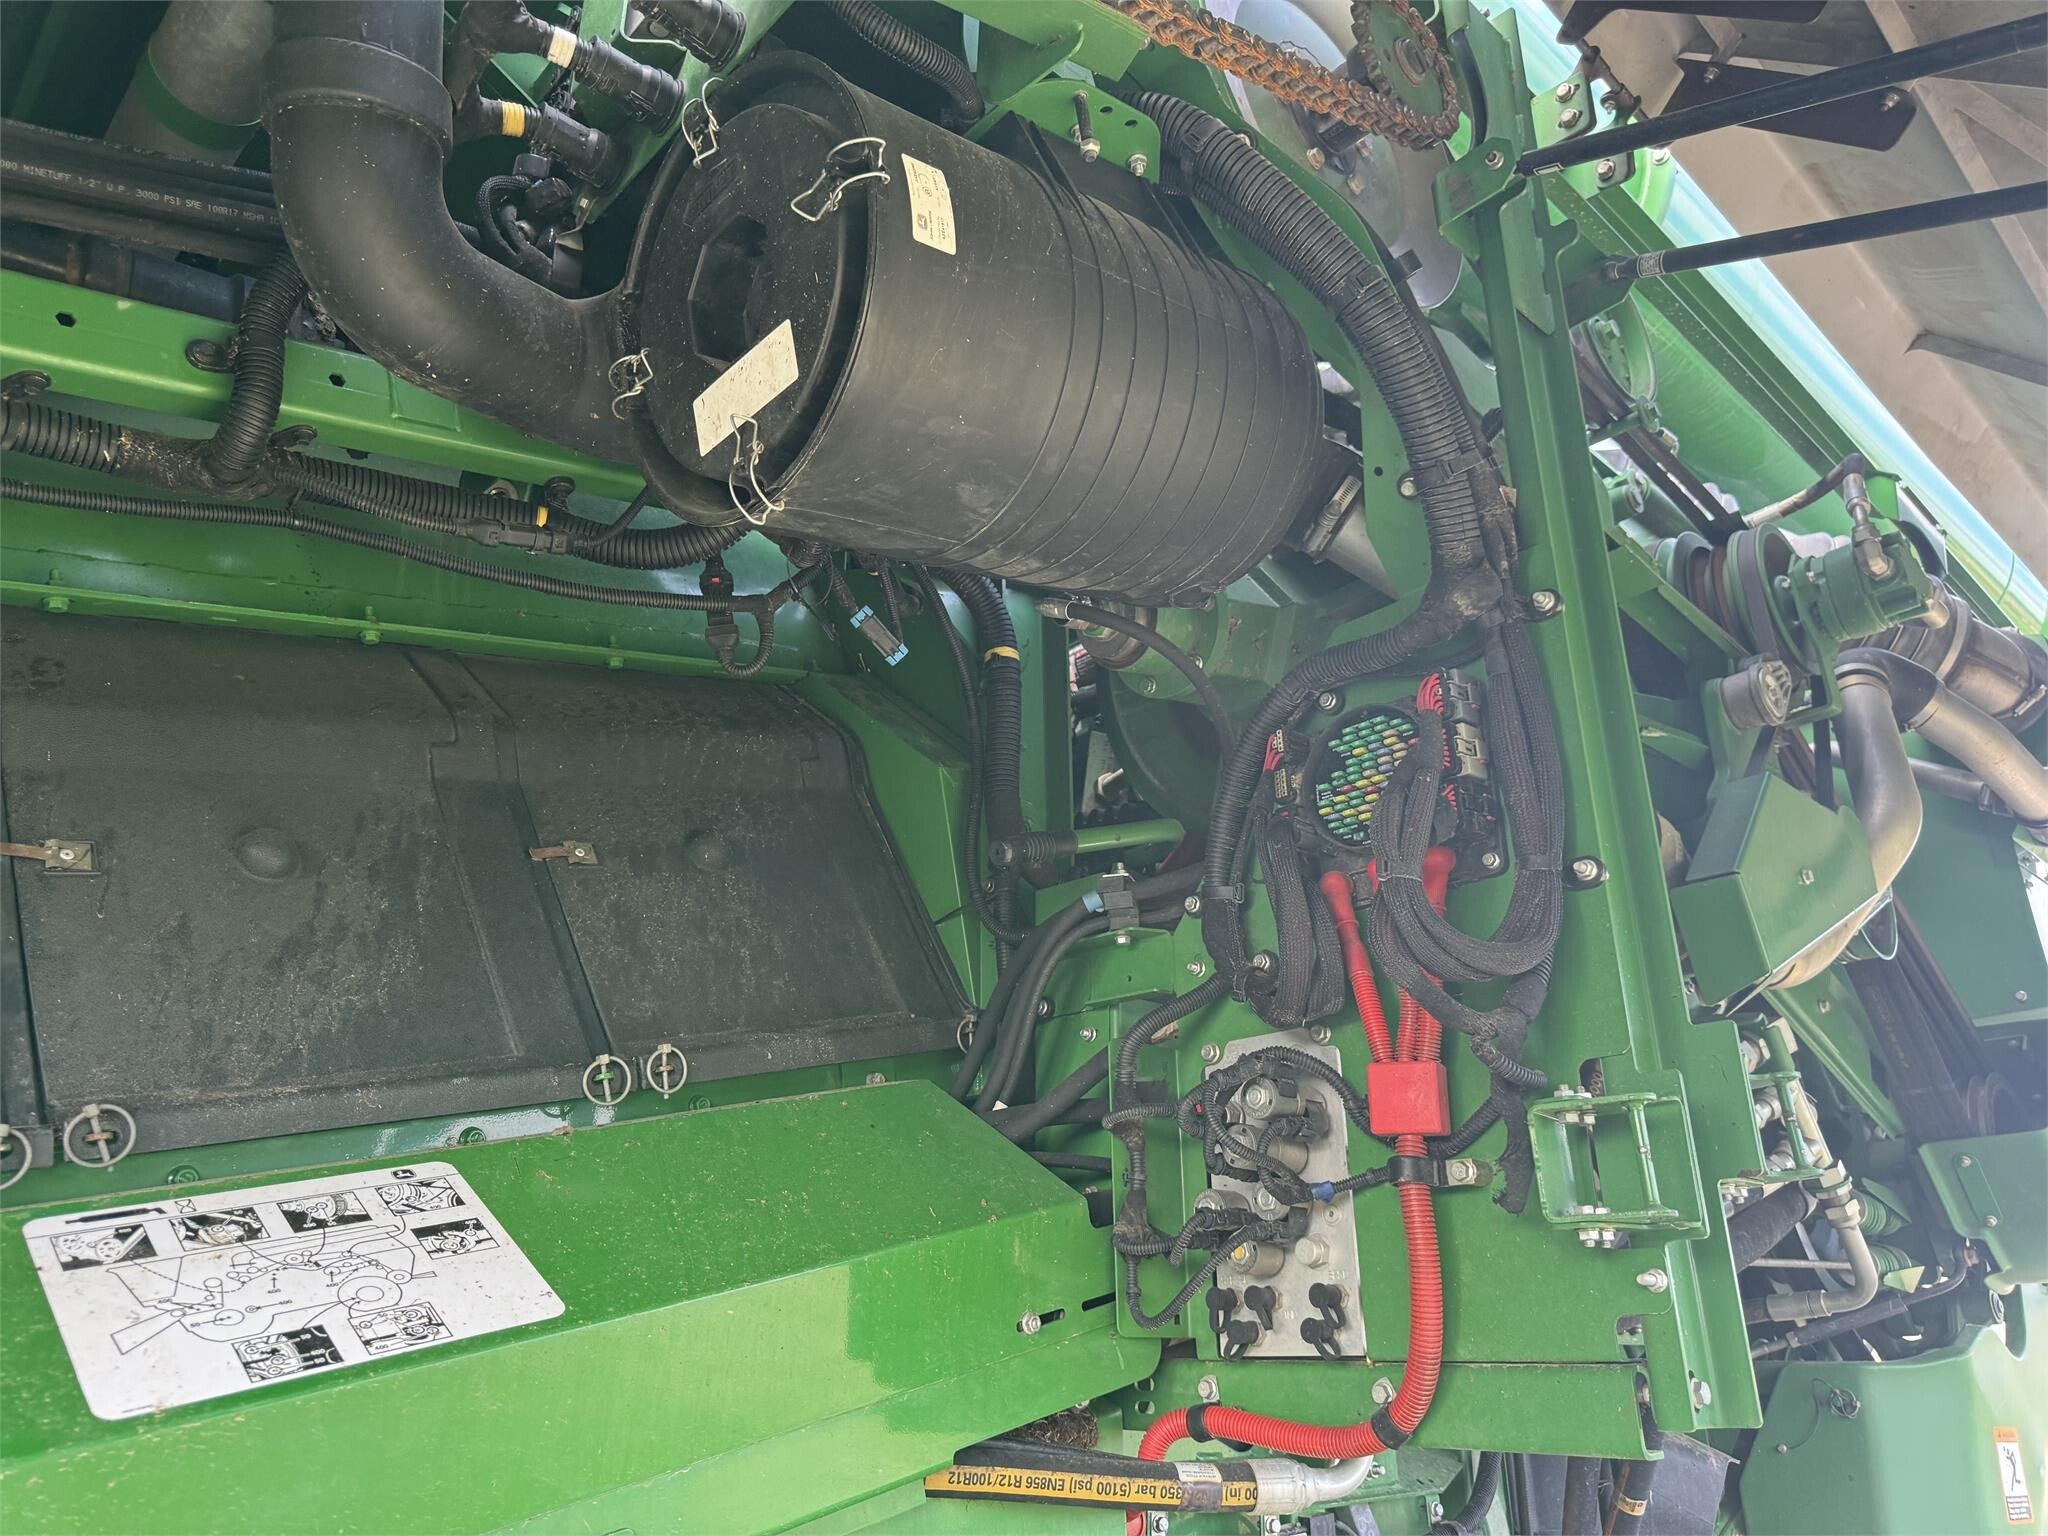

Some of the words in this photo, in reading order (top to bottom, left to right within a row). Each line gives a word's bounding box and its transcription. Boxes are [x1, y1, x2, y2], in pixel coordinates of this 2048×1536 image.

[23, 164, 72, 181] MINETUFF
[136, 188, 160, 201] 3000
[164, 194, 181, 206] PSI
[185, 199, 202, 211] SAE
[948, 1471, 1023, 1489] R12/100R12
[1025, 1475, 1065, 1492] EN856
[1069, 1476, 1093, 1494] psi)
[1096, 1481, 1131, 1498] (5100
[1135, 1483, 1157, 1499] bar
[1160, 1485, 1182, 1500] 350
[1225, 1485, 1241, 1502] in)
